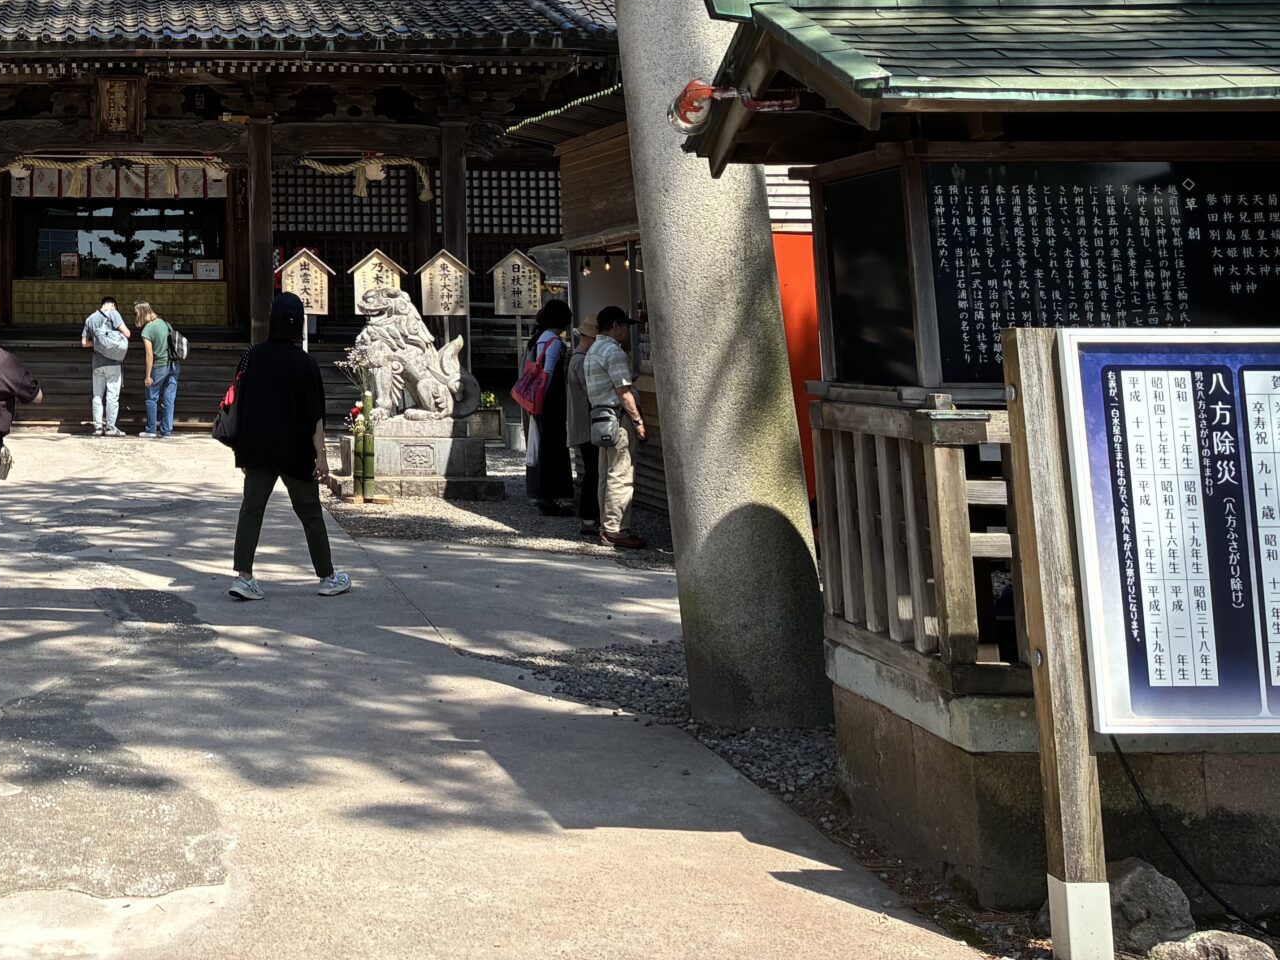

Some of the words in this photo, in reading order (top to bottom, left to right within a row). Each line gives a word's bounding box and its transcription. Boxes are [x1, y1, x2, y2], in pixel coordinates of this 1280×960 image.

[1252, 194, 1271, 276] 天照皇大神
[300, 261, 313, 309] 出雲大社
[438, 262, 453, 311] 東京大神宮
[511, 264, 523, 309] 日枝神社
[1151, 376, 1171, 470] 昭和四十七年生
[1194, 371, 1214, 496] 男女八方ふさがりの年まわり
[1208, 372, 1239, 485] 八方除災
[1252, 400, 1268, 445] 卒寿祝
[1161, 479, 1181, 575] 昭和五十六年生
[1183, 479, 1204, 575] 昭和二十九年生
[1257, 460, 1276, 520] 九十歳
[1147, 586, 1167, 680] 平成二十九年生
[1193, 586, 1213, 680] 昭和三十八年生
